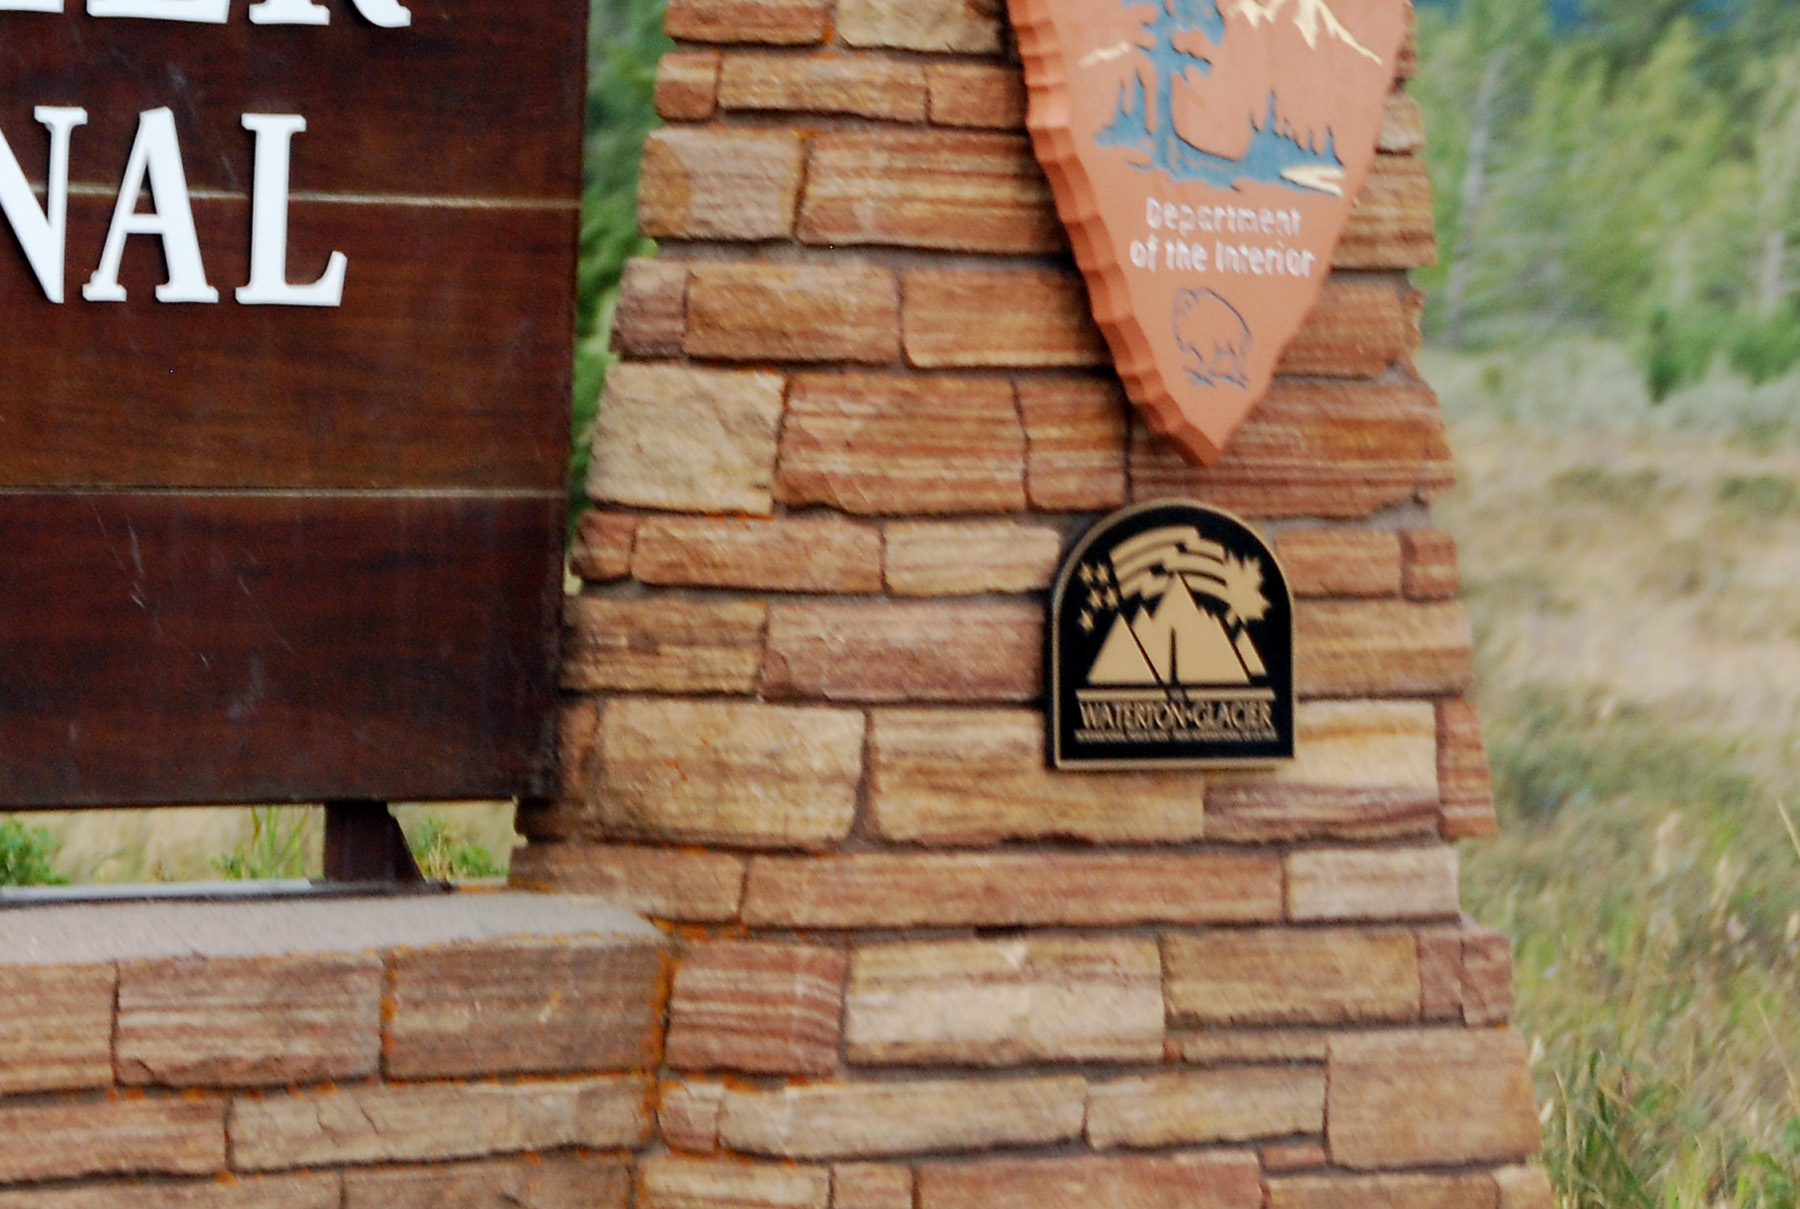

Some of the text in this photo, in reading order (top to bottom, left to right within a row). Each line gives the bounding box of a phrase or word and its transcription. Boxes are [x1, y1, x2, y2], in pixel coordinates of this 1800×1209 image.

[1146, 197, 1301, 237] Department
[1129, 234, 1316, 277] of the Interior
